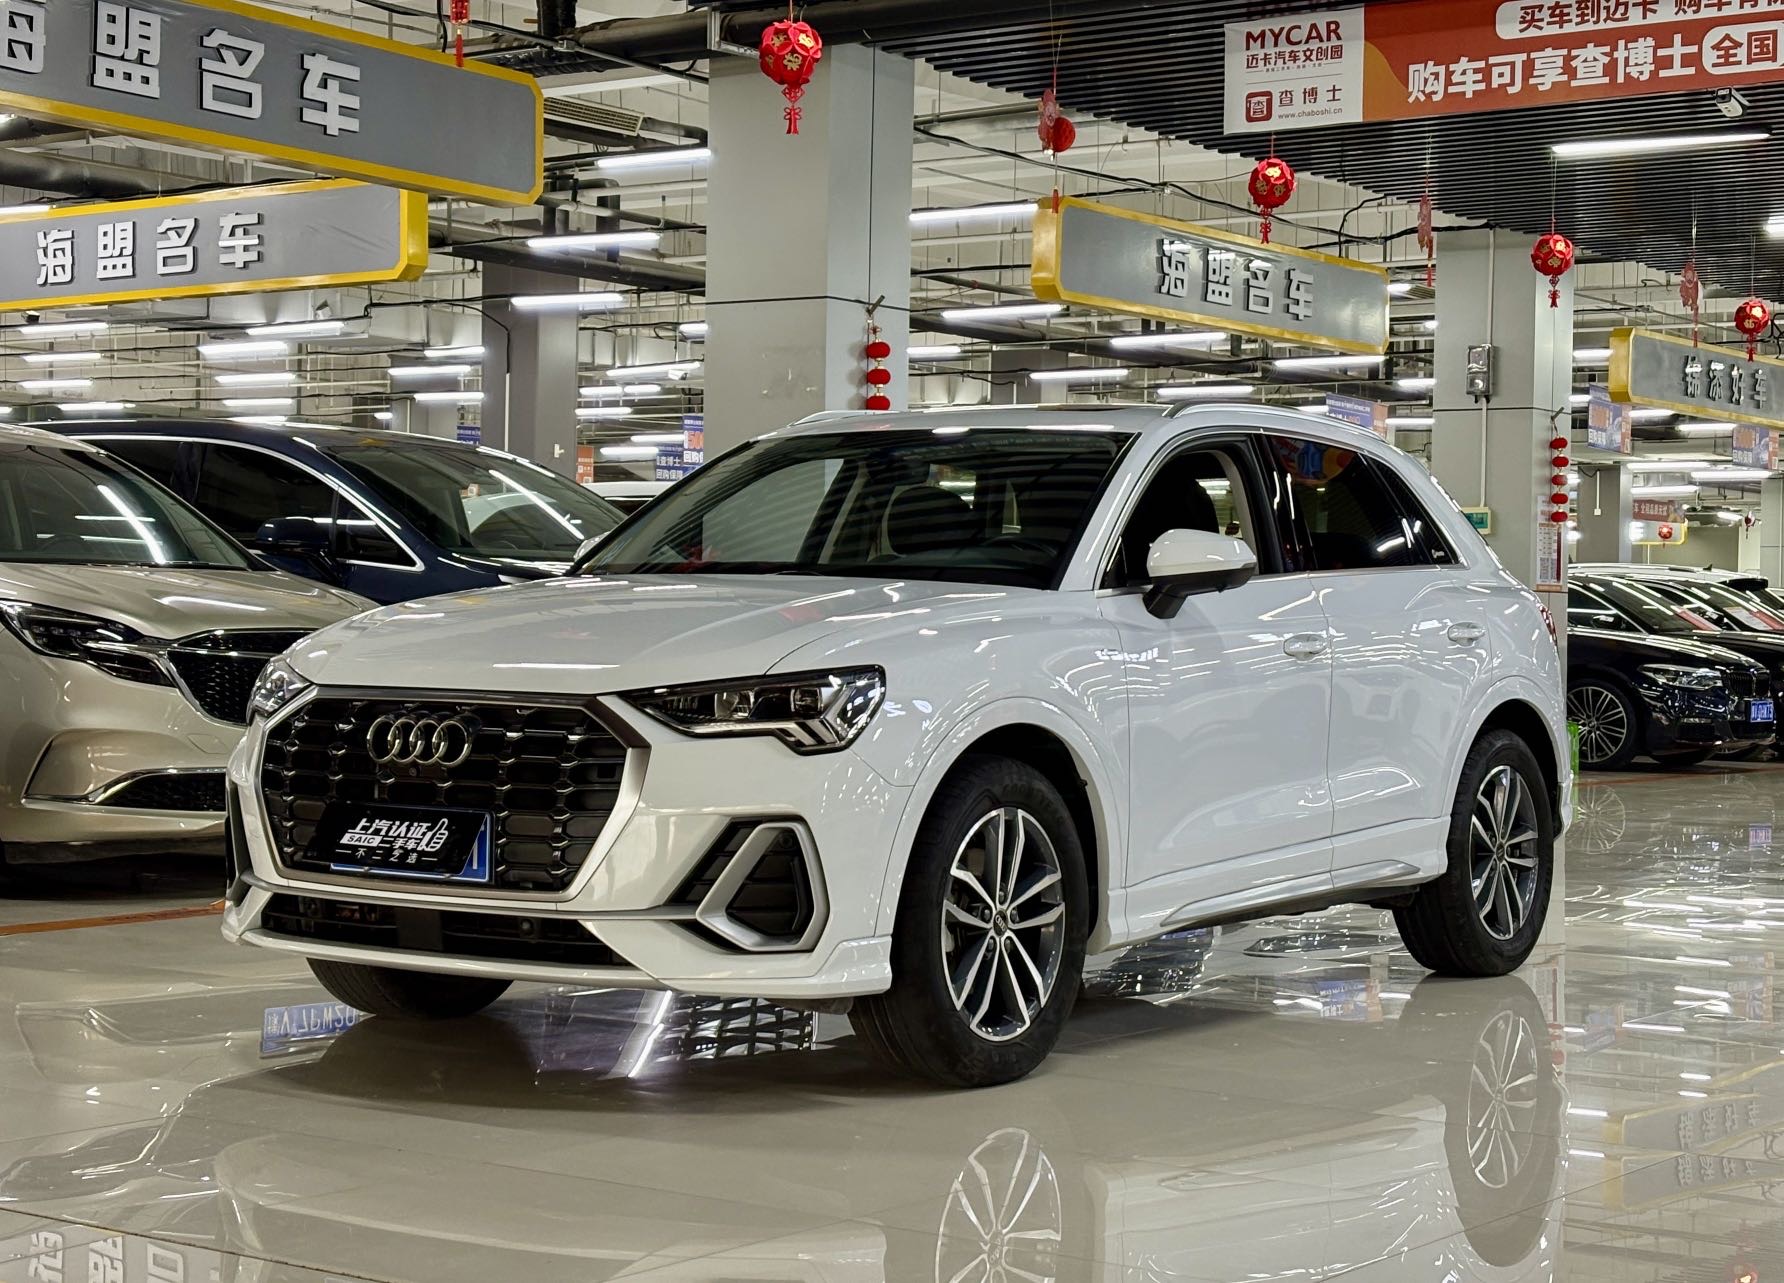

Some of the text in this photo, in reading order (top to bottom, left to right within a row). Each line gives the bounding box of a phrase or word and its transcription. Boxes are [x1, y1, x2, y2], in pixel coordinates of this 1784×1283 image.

[1518, 0, 1658, 33] 买车到迈卡
[1245, 20, 1342, 51] MYCAR
[1245, 44, 1343, 69] 迈卡汽车文创园
[1407, 33, 1698, 104] 购车可享查博士
[1278, 84, 1342, 107] 查博士
[1278, 107, 1342, 119] www.chaboshi.cn
[37, 213, 263, 286] 海盟名车
[1159, 239, 1313, 321] 海盟名车
[347, 818, 432, 839] 上汽认证
[346, 834, 420, 851] SAIC 二手车
[355, 848, 419, 864] 不二之选
